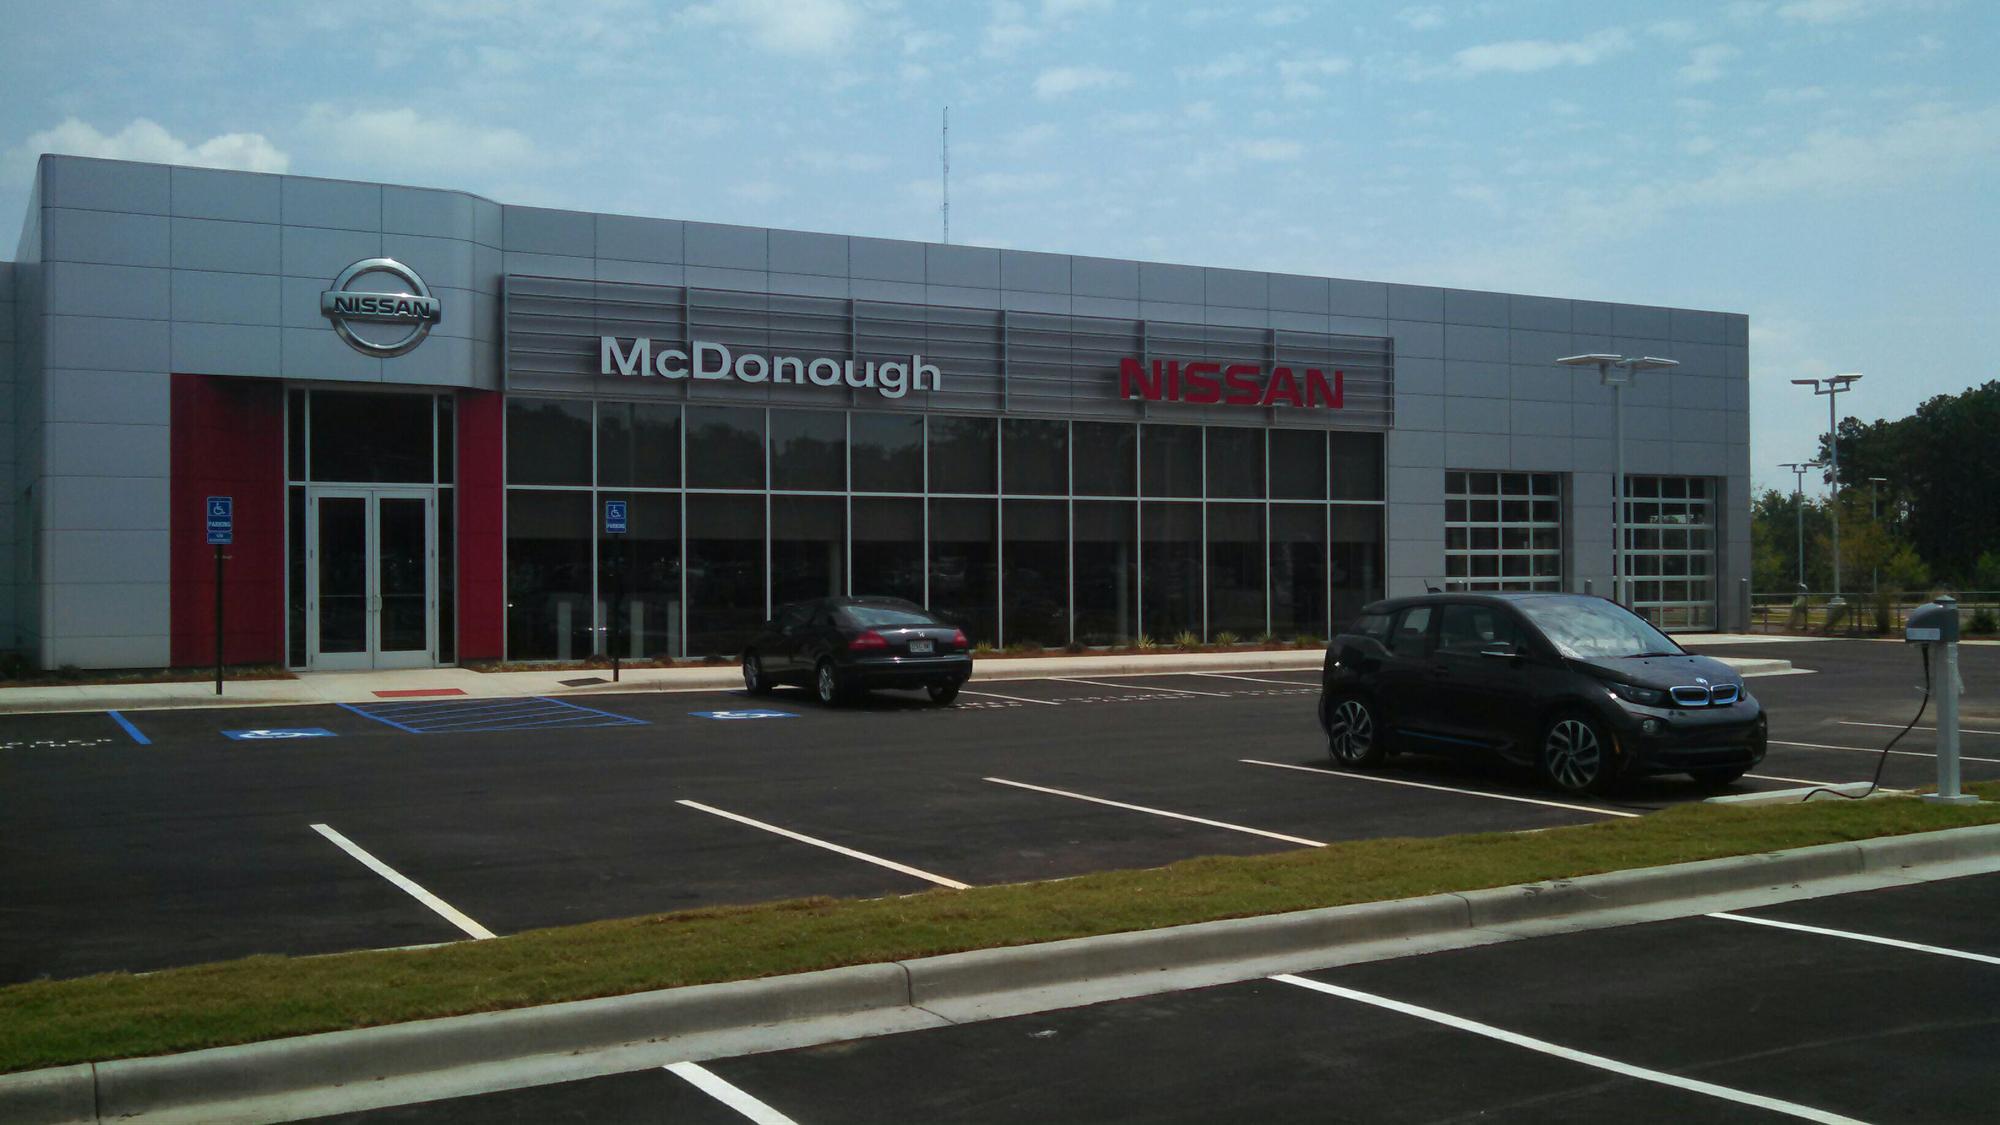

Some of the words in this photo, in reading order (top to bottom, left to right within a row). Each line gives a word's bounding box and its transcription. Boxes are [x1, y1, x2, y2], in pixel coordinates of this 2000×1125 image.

[334, 296, 430, 318] NISSAN
[600, 335, 942, 399] McDonough
[1119, 357, 1344, 409] NISSAN
